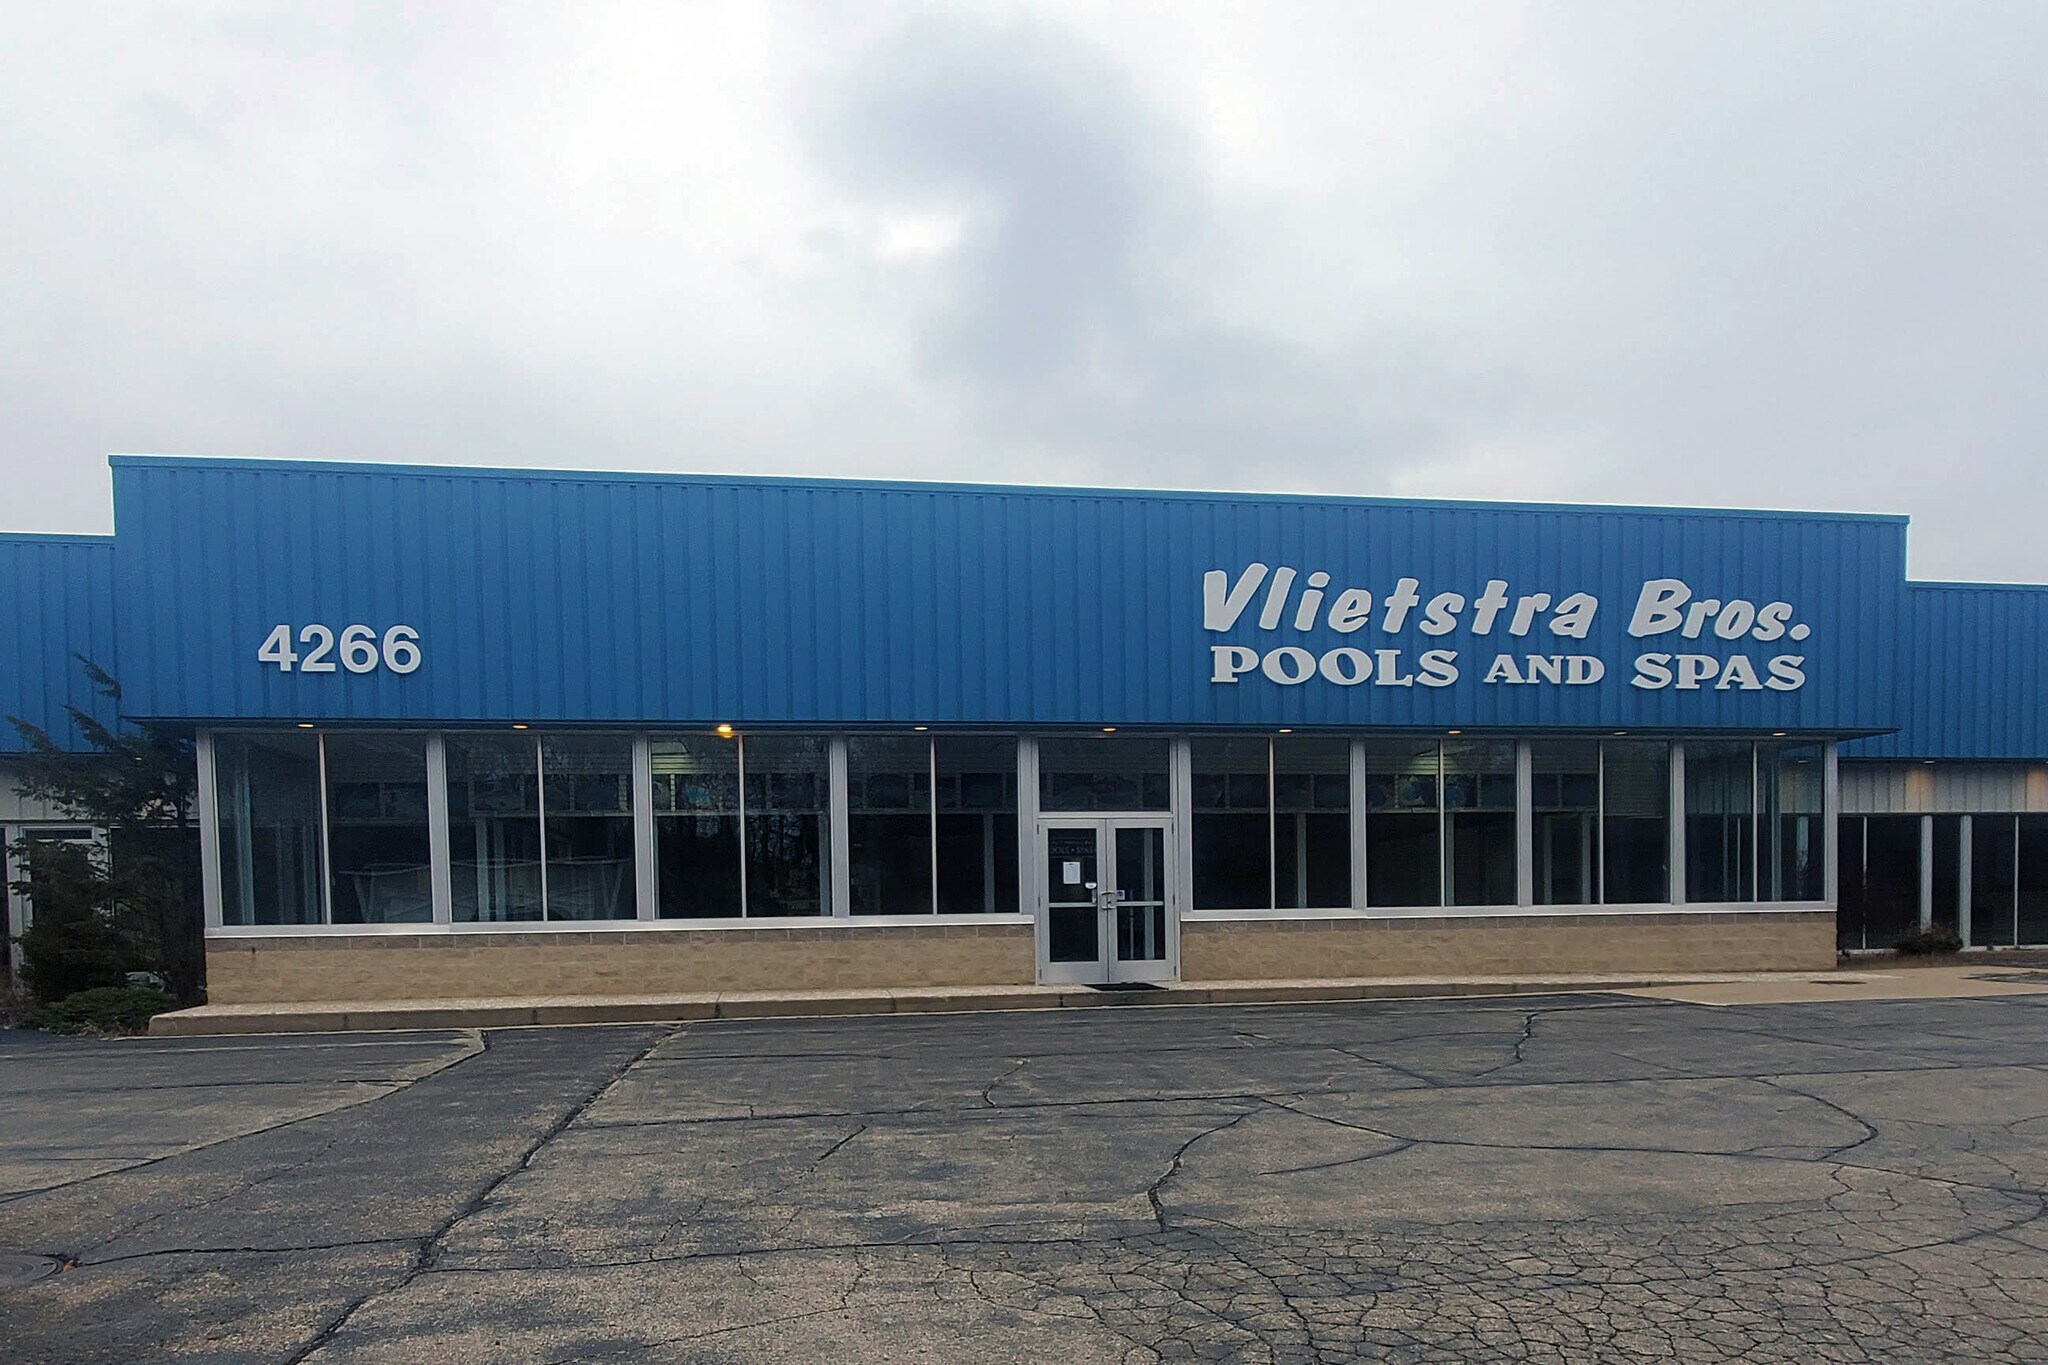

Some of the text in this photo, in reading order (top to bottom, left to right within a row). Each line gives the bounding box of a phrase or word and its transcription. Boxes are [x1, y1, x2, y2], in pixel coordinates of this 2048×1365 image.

[1203, 562, 1811, 641] Vlietstra Bros.
[257, 624, 421, 674] 4266
[1210, 645, 1806, 691] POOLS AND SPAS
